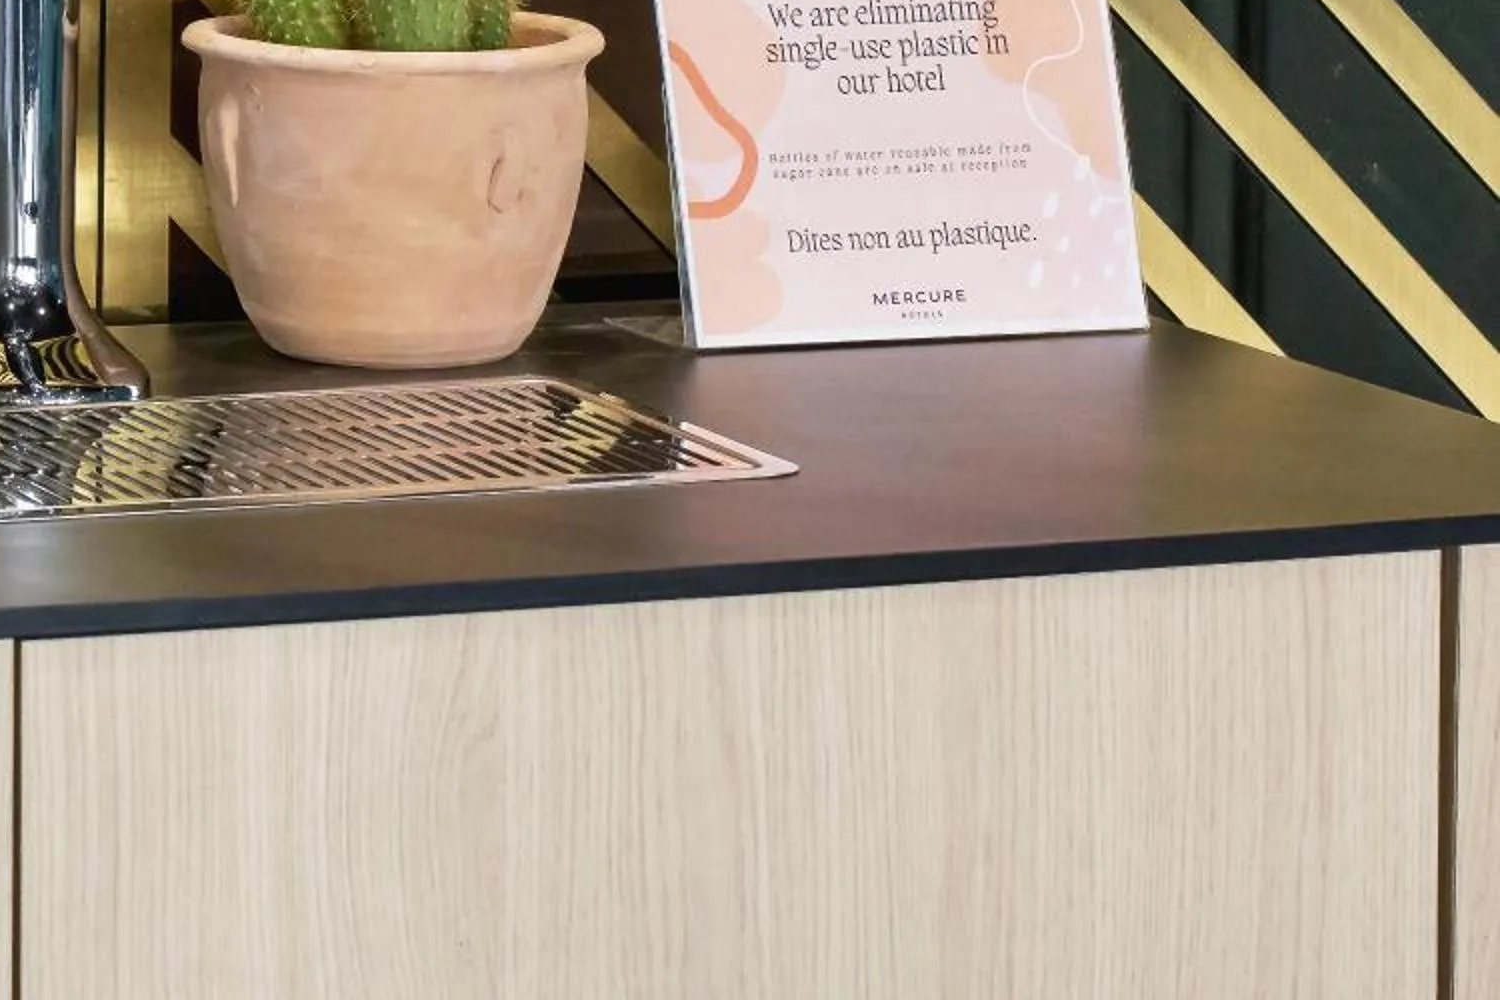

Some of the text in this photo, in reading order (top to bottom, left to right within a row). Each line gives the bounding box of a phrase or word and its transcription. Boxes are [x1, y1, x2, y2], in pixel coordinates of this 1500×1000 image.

[768, 3, 803, 28] We
[809, 4, 849, 27] are
[765, 29, 1010, 69] single-use plastic in
[837, 64, 946, 95] our hotel
[787, 221, 1038, 254] Dites non au plastique.
[872, 289, 966, 305] MERCURE
